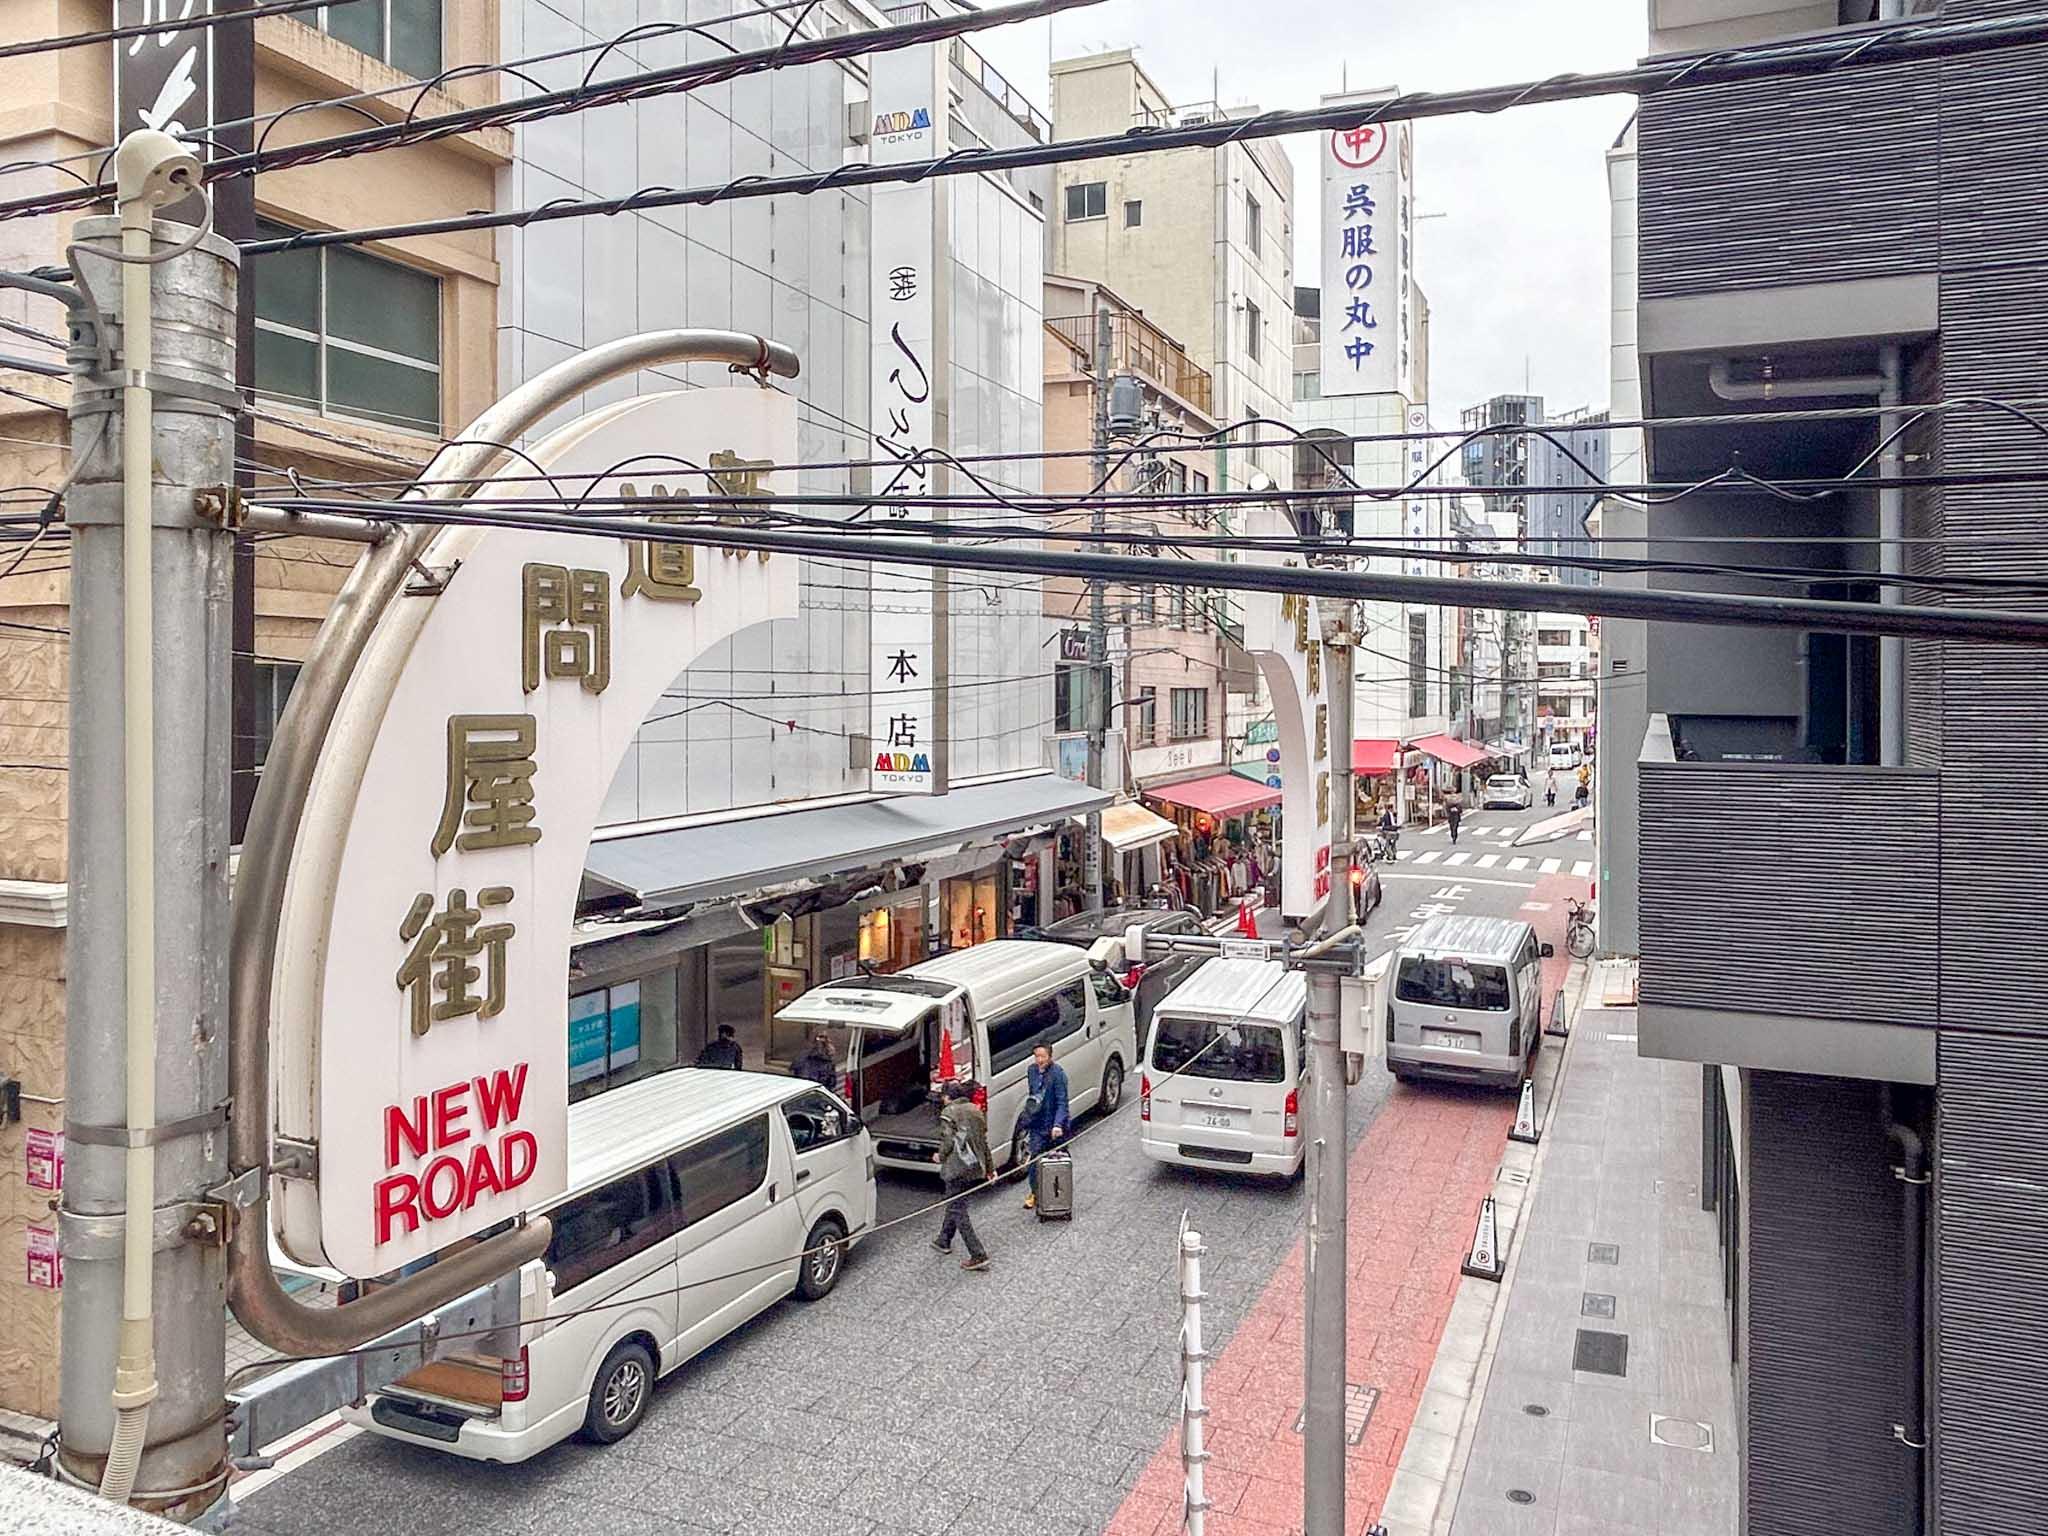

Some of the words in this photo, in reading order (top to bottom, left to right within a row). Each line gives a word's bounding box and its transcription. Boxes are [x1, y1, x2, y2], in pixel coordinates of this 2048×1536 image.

[873, 108, 930, 136] MDM
[880, 131, 923, 144] TOKYO
[1341, 184, 1378, 372] 呉服の丸中
[886, 649, 918, 748] 本店
[875, 753, 931, 773] MDM
[881, 774, 923, 783] TOKYO
[384, 1063, 528, 1169] NEW
[374, 1130, 538, 1247] ROAD
